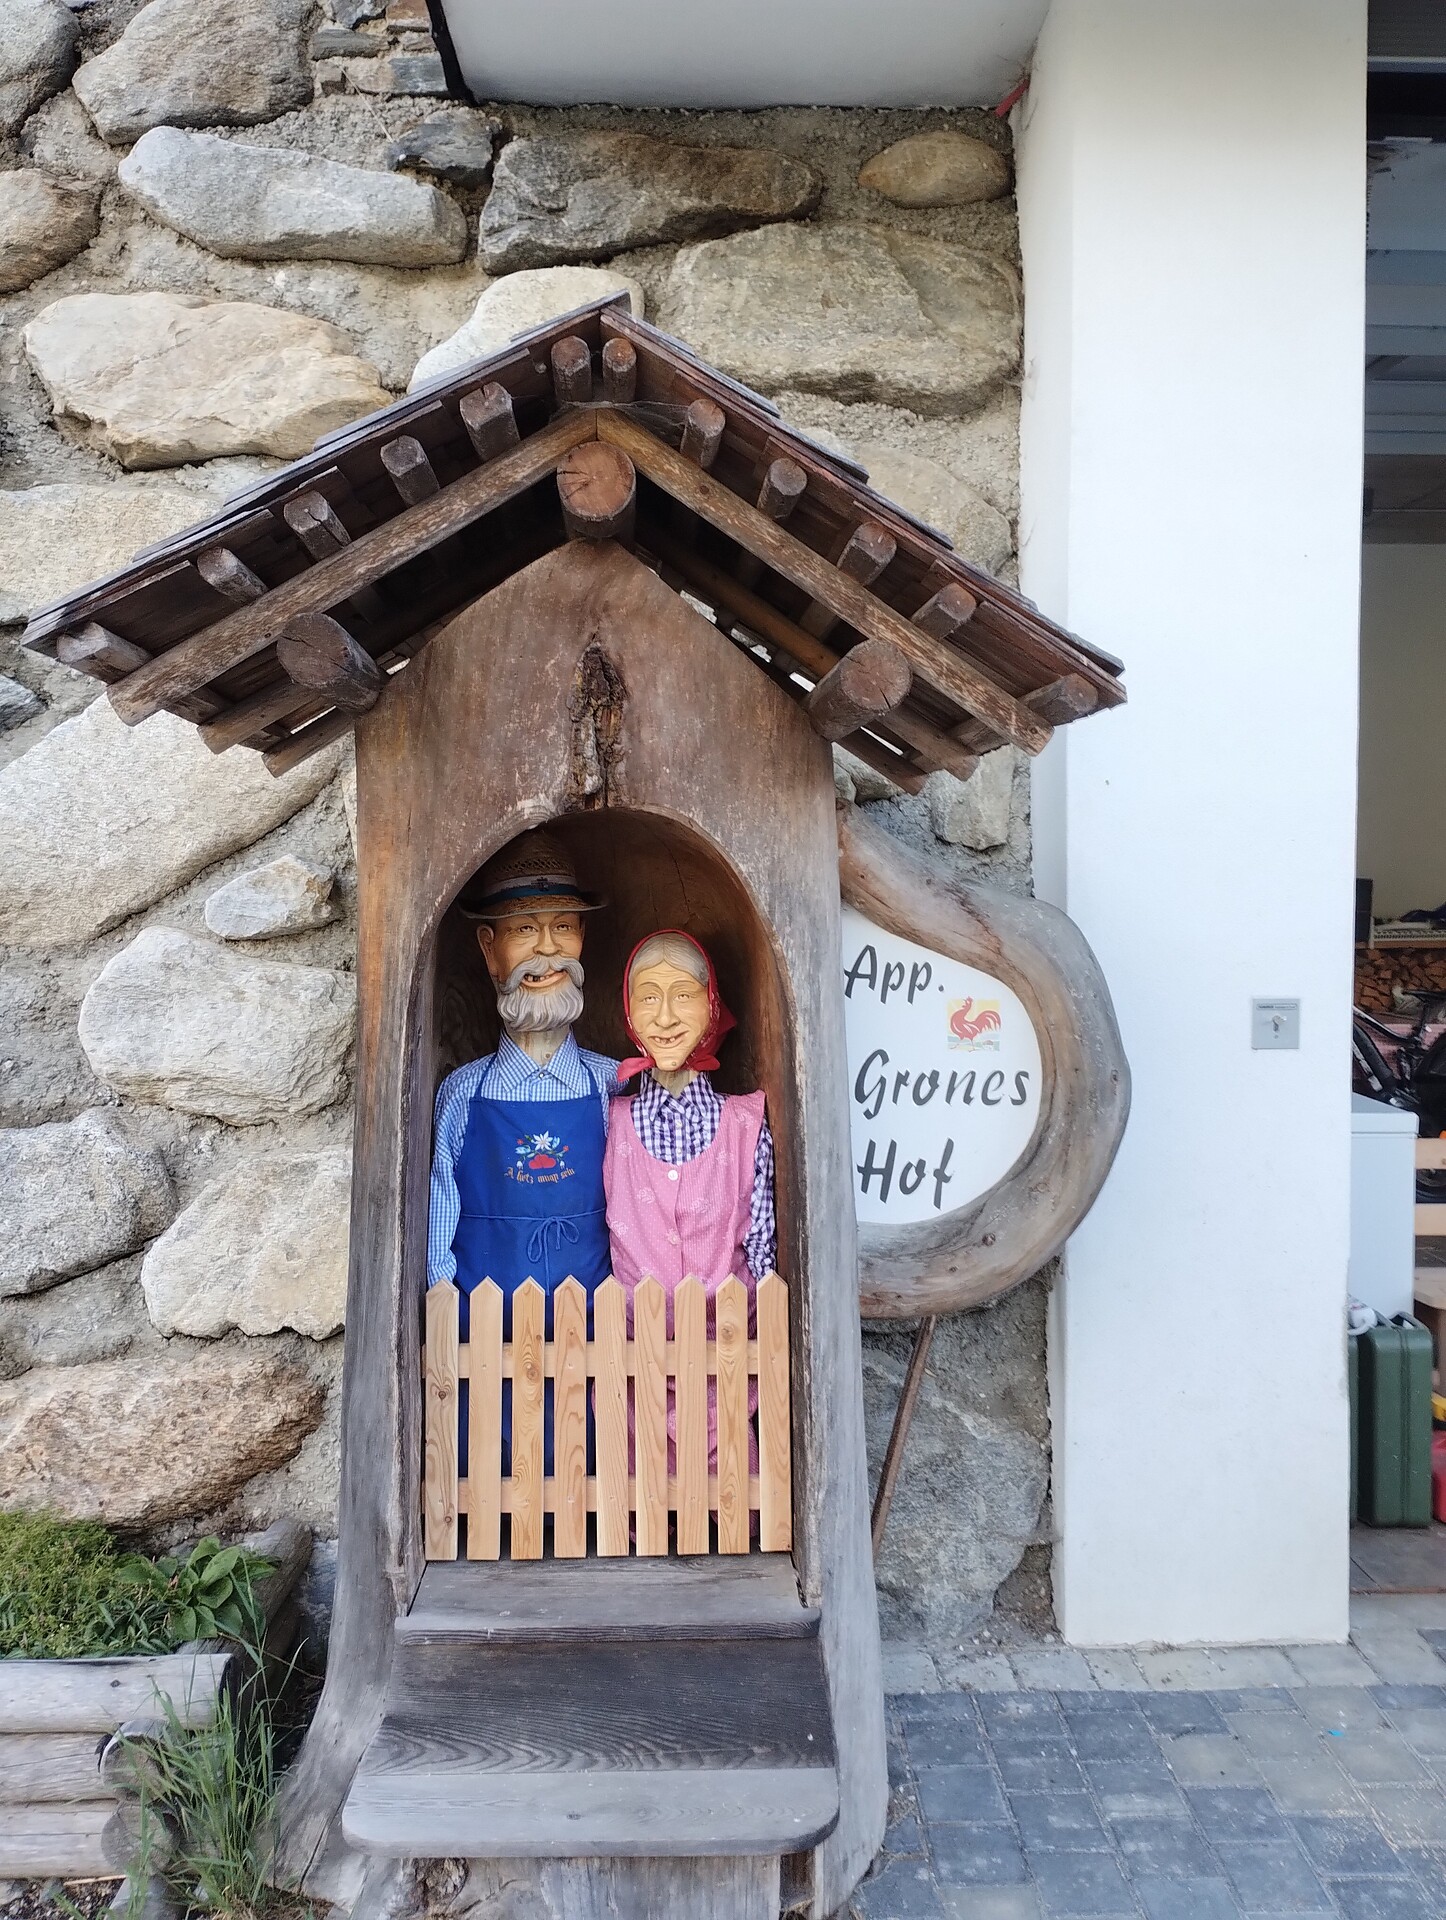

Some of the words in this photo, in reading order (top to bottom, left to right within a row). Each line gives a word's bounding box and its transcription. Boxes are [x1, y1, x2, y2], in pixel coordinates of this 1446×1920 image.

[844, 944, 945, 1004] App.
[854, 1049, 1030, 1120] Grones
[856, 1138, 954, 1210] Hof
